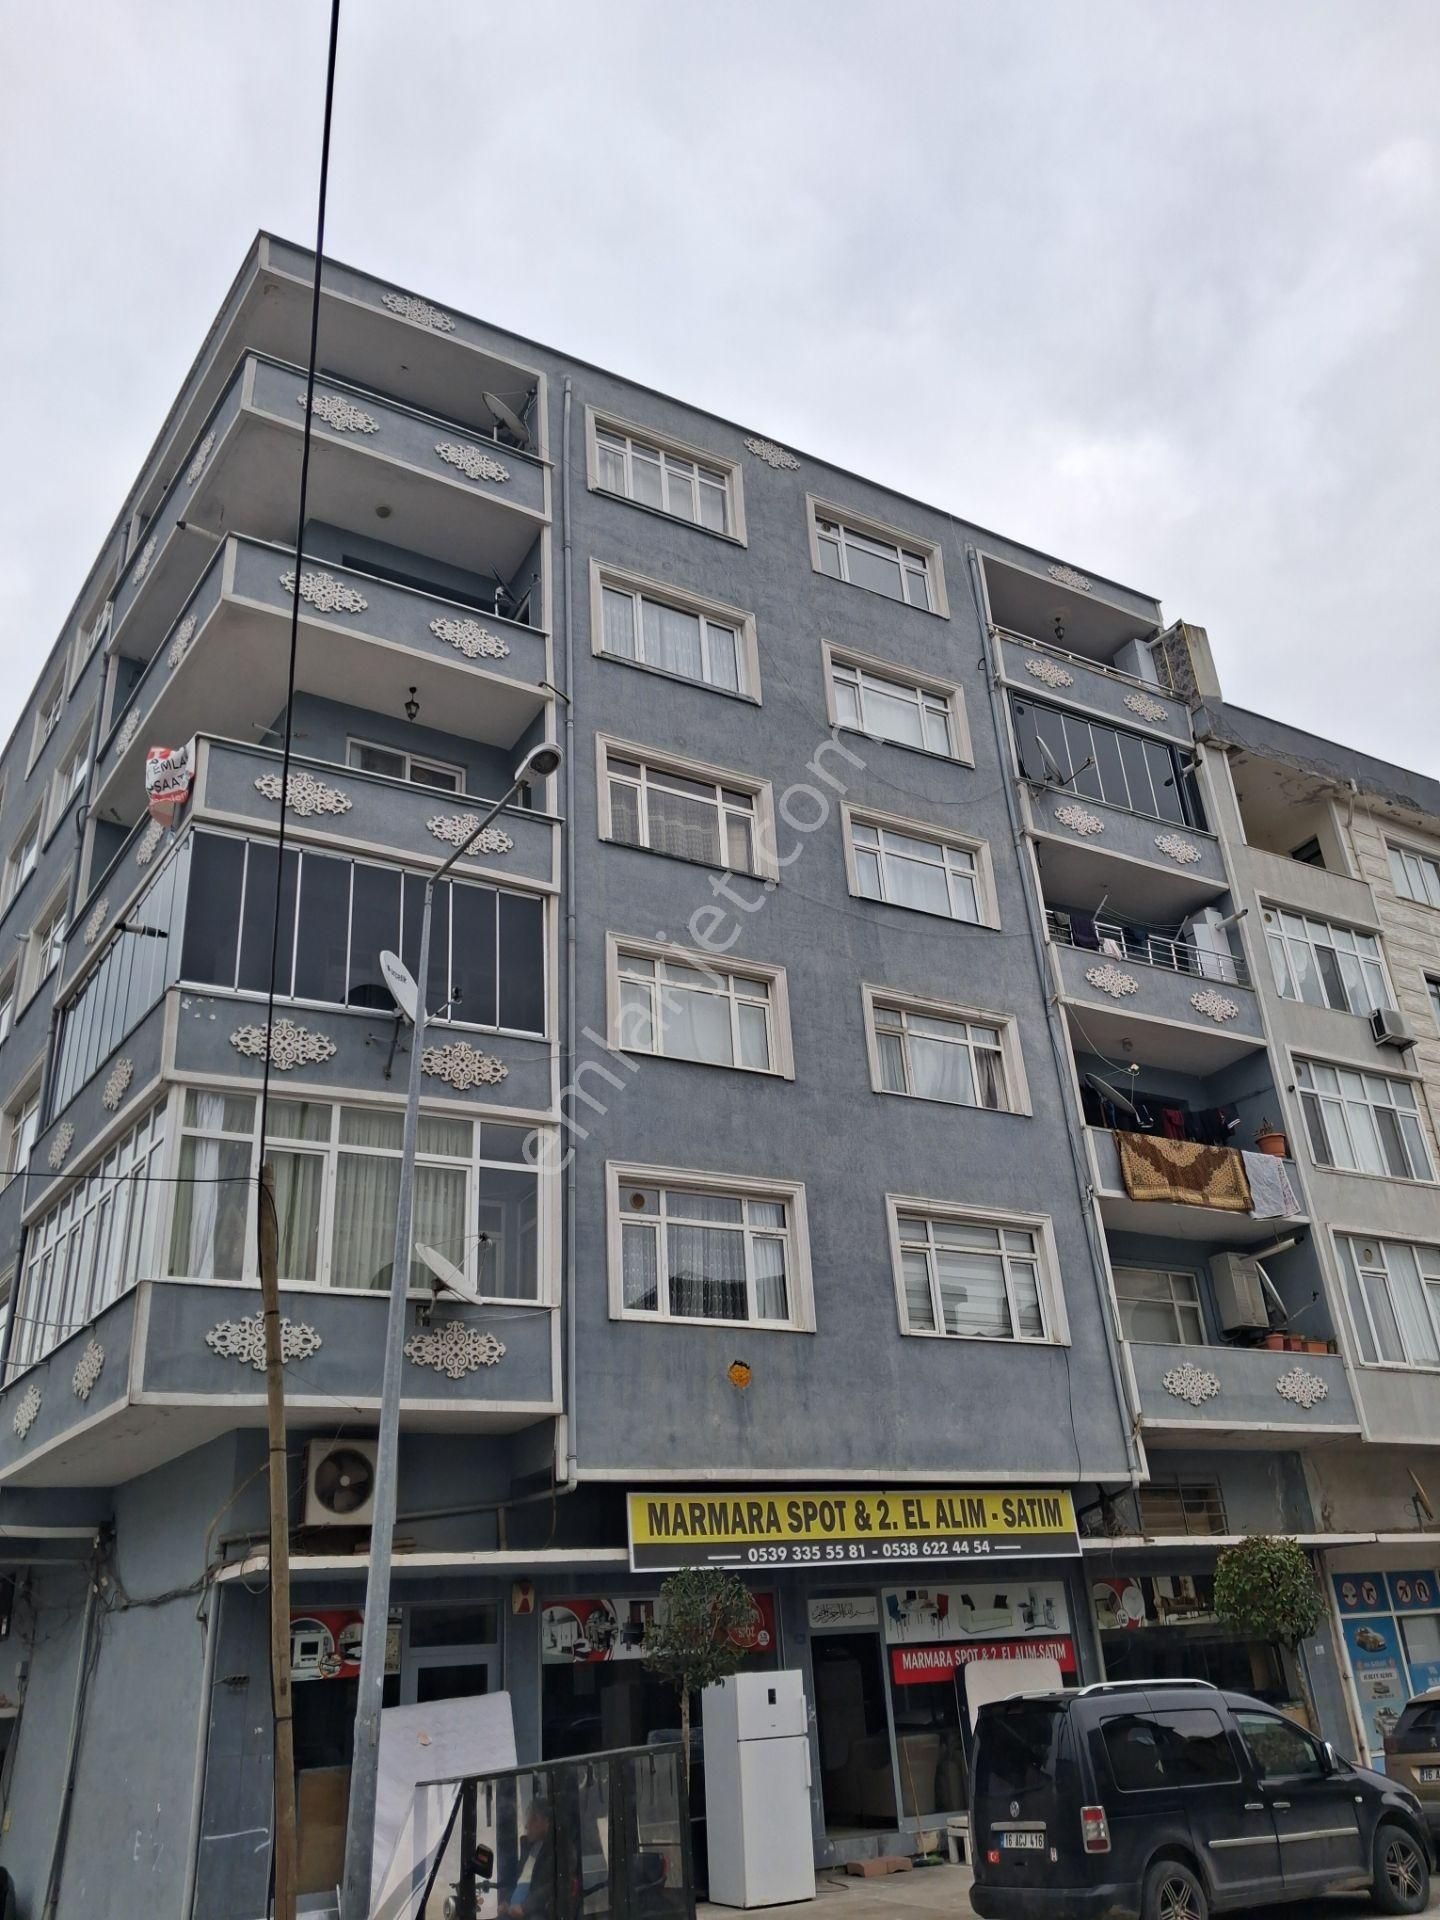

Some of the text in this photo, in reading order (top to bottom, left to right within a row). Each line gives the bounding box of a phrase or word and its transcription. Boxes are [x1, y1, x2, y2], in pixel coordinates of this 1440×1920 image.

[647, 1501, 782, 1536] MARMARA
[787, 1500, 846, 1533] SPOT
[854, 1500, 872, 1531] &
[877, 1499, 898, 1530] 2.
[903, 1499, 930, 1530] EL
[936, 1498, 987, 1528] ALIM
[1001, 1498, 1063, 1528] SATIM
[748, 1547, 787, 1562] 0539
[792, 1546, 821, 1560] 335
[826, 1545, 844, 1559] 55
[849, 1544, 865, 1558] 81
[882, 1542, 918, 1556] 0538
[922, 1541, 948, 1555] 622
[952, 1541, 969, 1553] 44
[973, 1540, 990, 1553] 54
[902, 1650, 953, 1670] MARMARA
